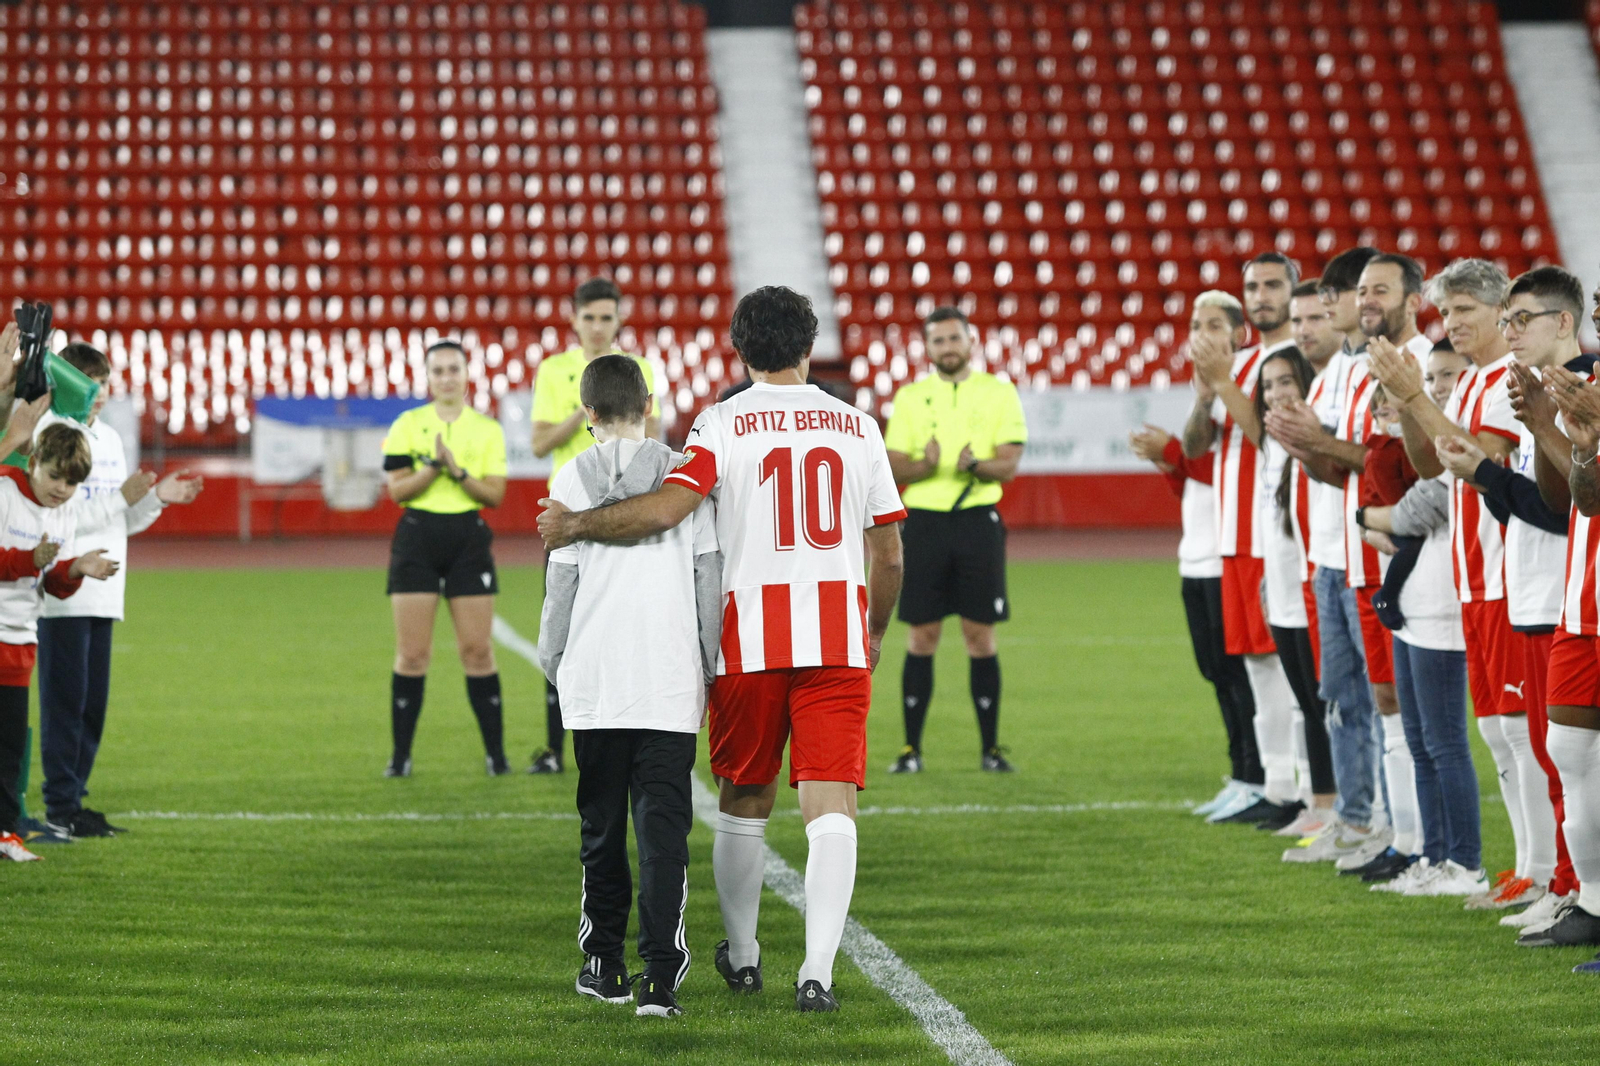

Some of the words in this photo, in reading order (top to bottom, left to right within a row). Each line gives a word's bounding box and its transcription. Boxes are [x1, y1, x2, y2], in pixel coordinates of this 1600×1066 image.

[734, 411, 787, 437] ORTIZ
[794, 410, 865, 439] BERNAL
[758, 446, 844, 551] 10
